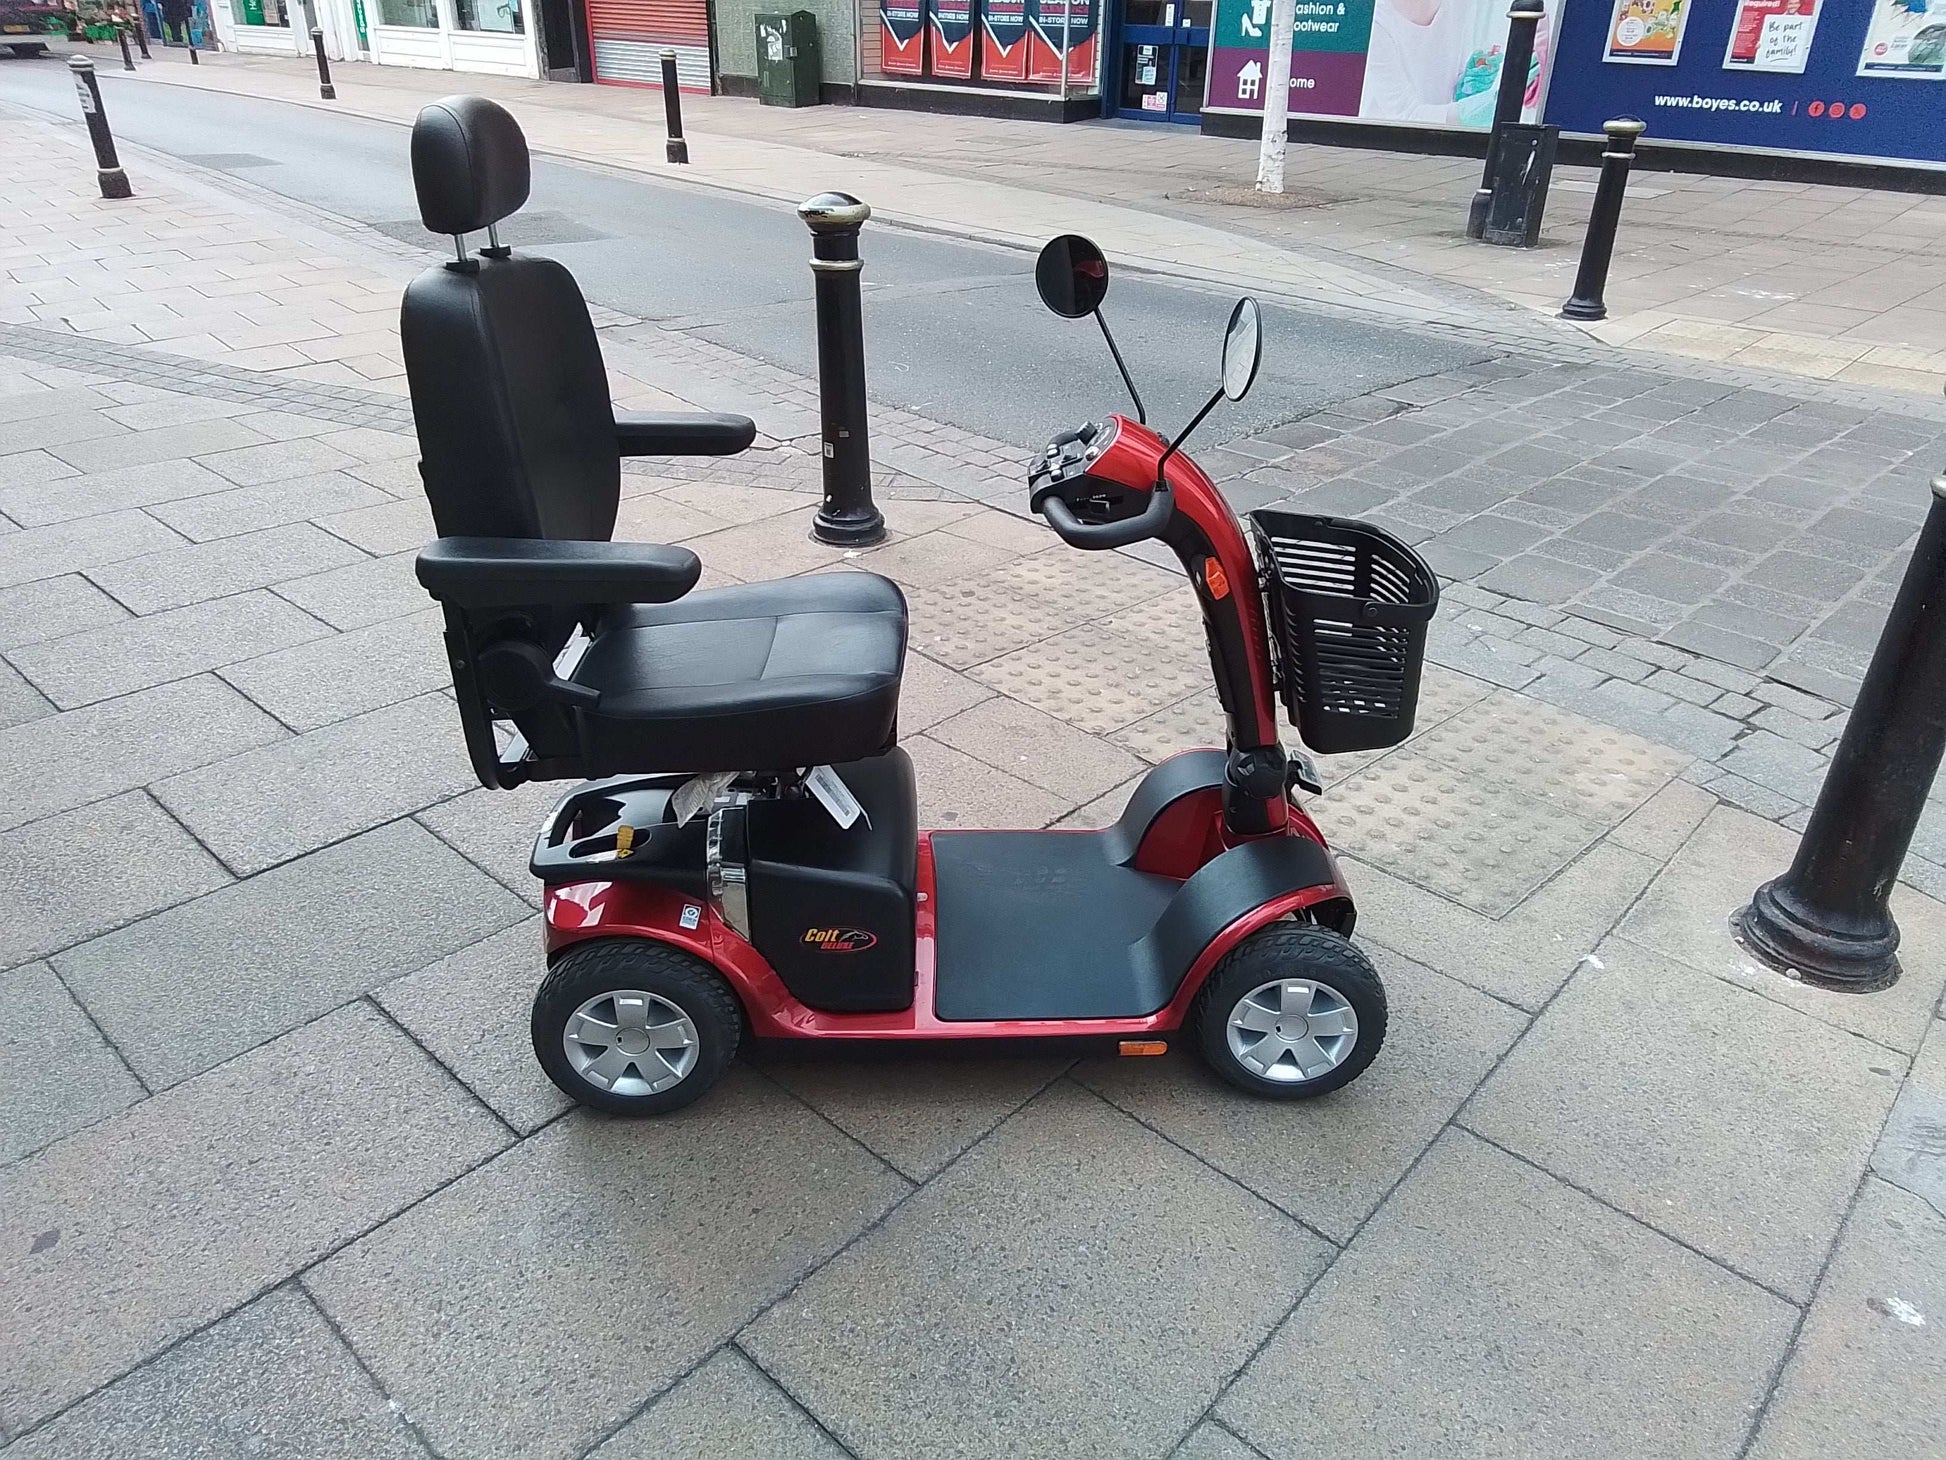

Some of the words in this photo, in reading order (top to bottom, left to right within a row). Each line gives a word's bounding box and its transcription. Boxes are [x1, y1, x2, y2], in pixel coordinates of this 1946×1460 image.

[1296, 2, 1334, 15] ashion
[1336, 2, 1346, 15] &
[1039, 16, 1066, 25] IN-STOR
[1070, 17, 1088, 25] NOW
[1293, 19, 1339, 33] ootwear
[1769, 21, 1780, 32] Be
[1783, 22, 1803, 33] part
[1770, 37, 1778, 46] of
[1783, 34, 1797, 43] the
[1289, 78, 1315, 88] ome
[1654, 95, 1783, 113] www.boyes.co.uk
[804, 928, 840, 942] Colt
